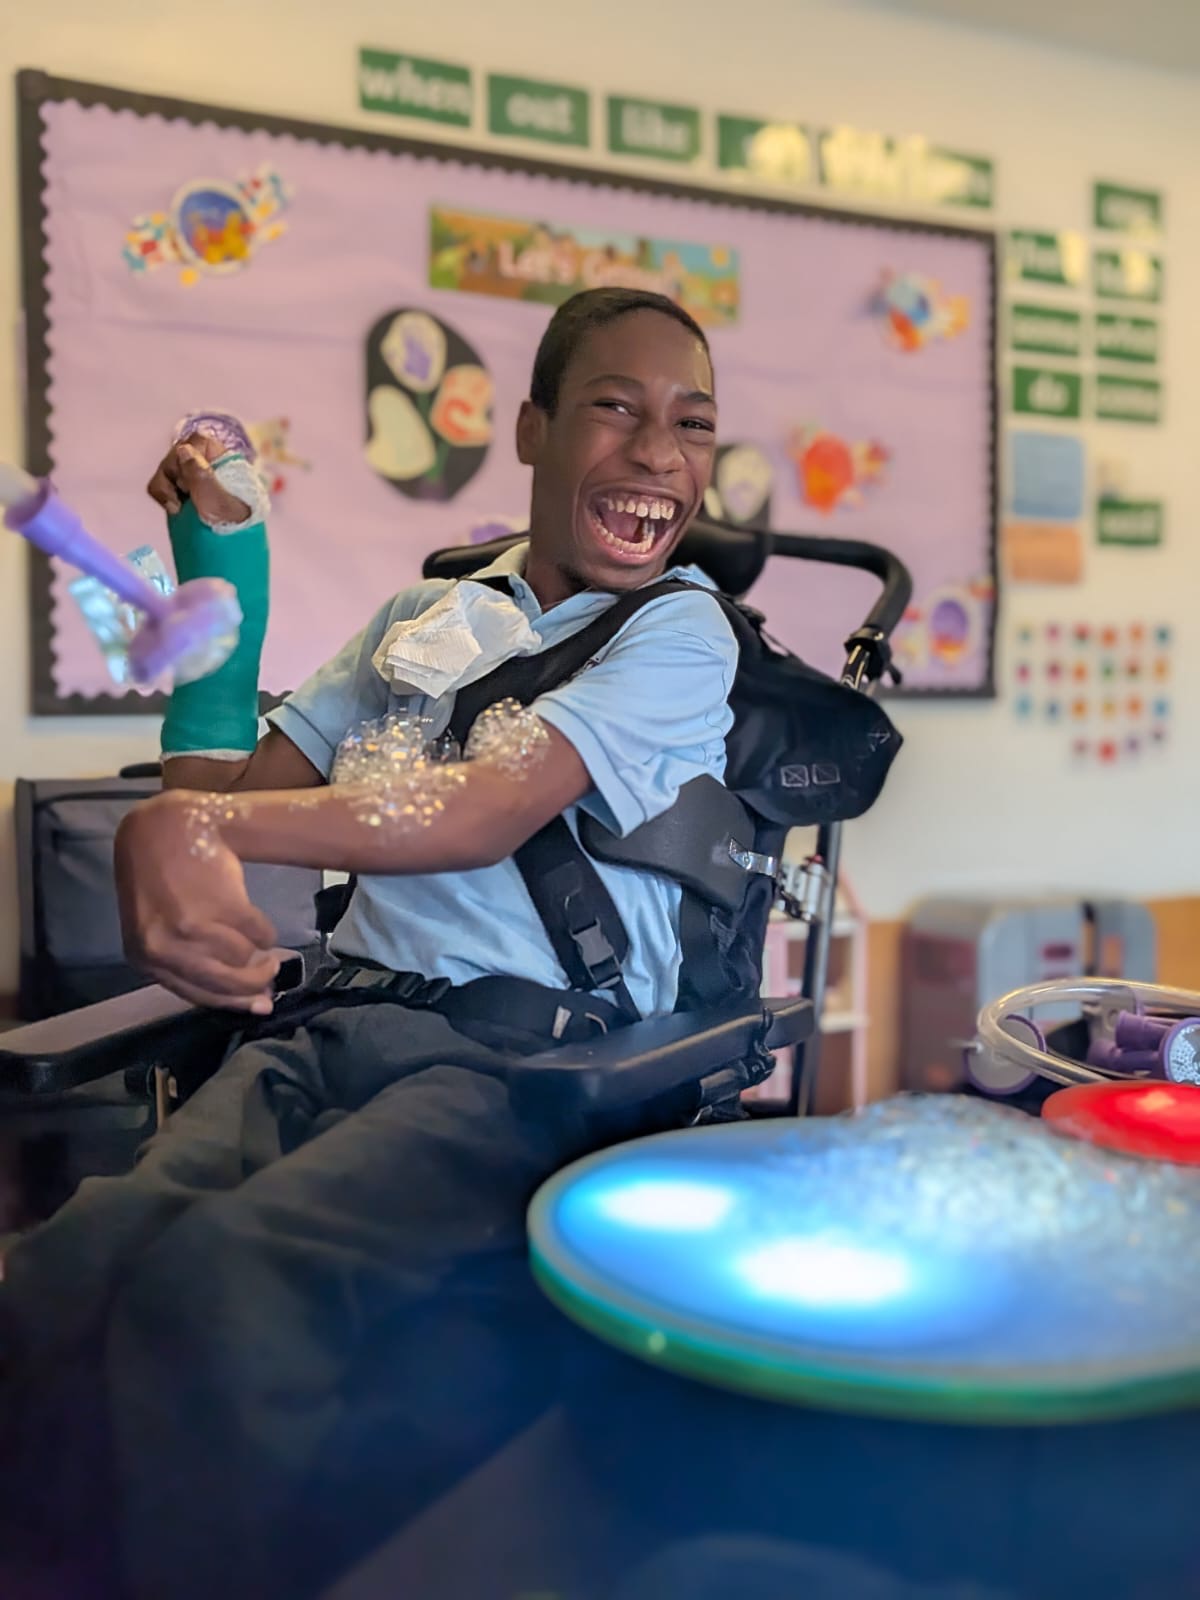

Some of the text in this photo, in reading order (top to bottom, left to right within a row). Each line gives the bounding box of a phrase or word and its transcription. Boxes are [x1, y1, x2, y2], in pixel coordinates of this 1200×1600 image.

[361, 59, 472, 117] when
[506, 93, 574, 134] out
[498, 240, 576, 286] Let's
